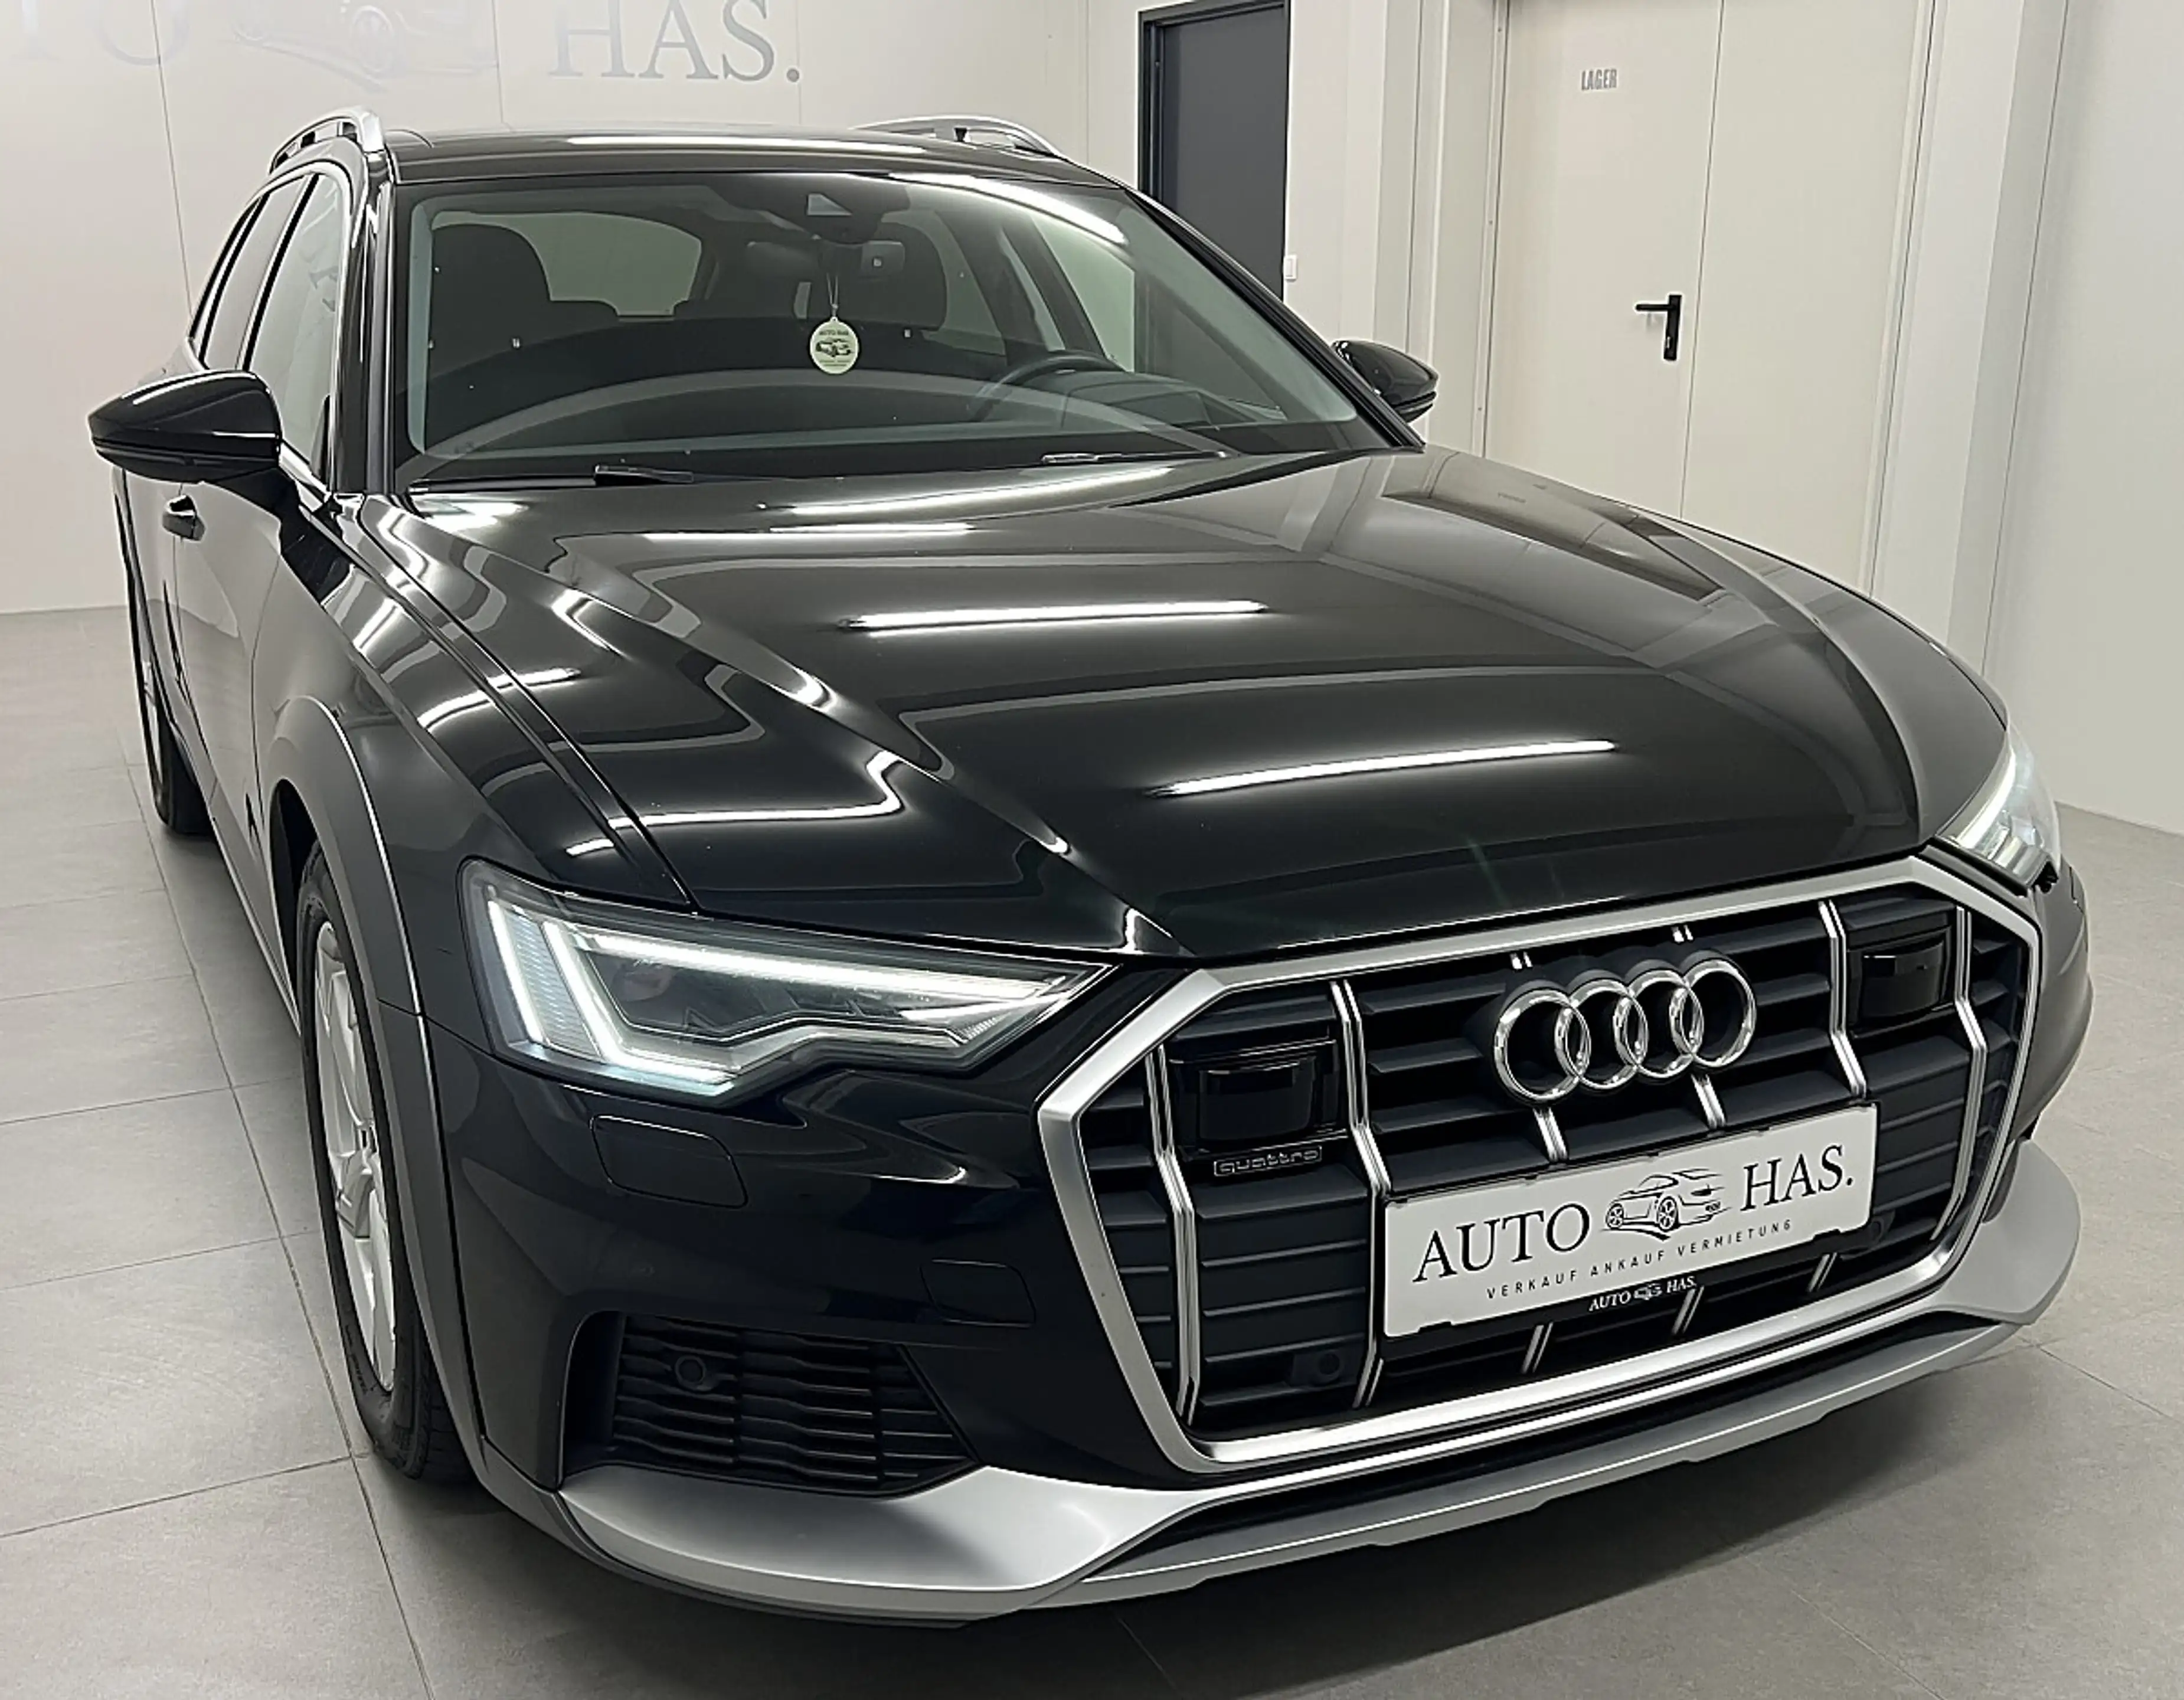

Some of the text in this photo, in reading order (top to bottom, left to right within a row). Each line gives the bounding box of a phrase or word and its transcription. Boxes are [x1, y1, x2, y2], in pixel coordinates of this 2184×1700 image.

[548, 0, 800, 82] HAS.
[1581, 68, 1617, 90] LAGER
[1218, 1150, 1319, 1173] quattro
[1413, 1144, 1853, 1282] AUTO HAS.
[1486, 1219, 1791, 1299] VERKAUF ANKAUF VERMIETUNG
[1589, 1290, 1631, 1311] AUTO
